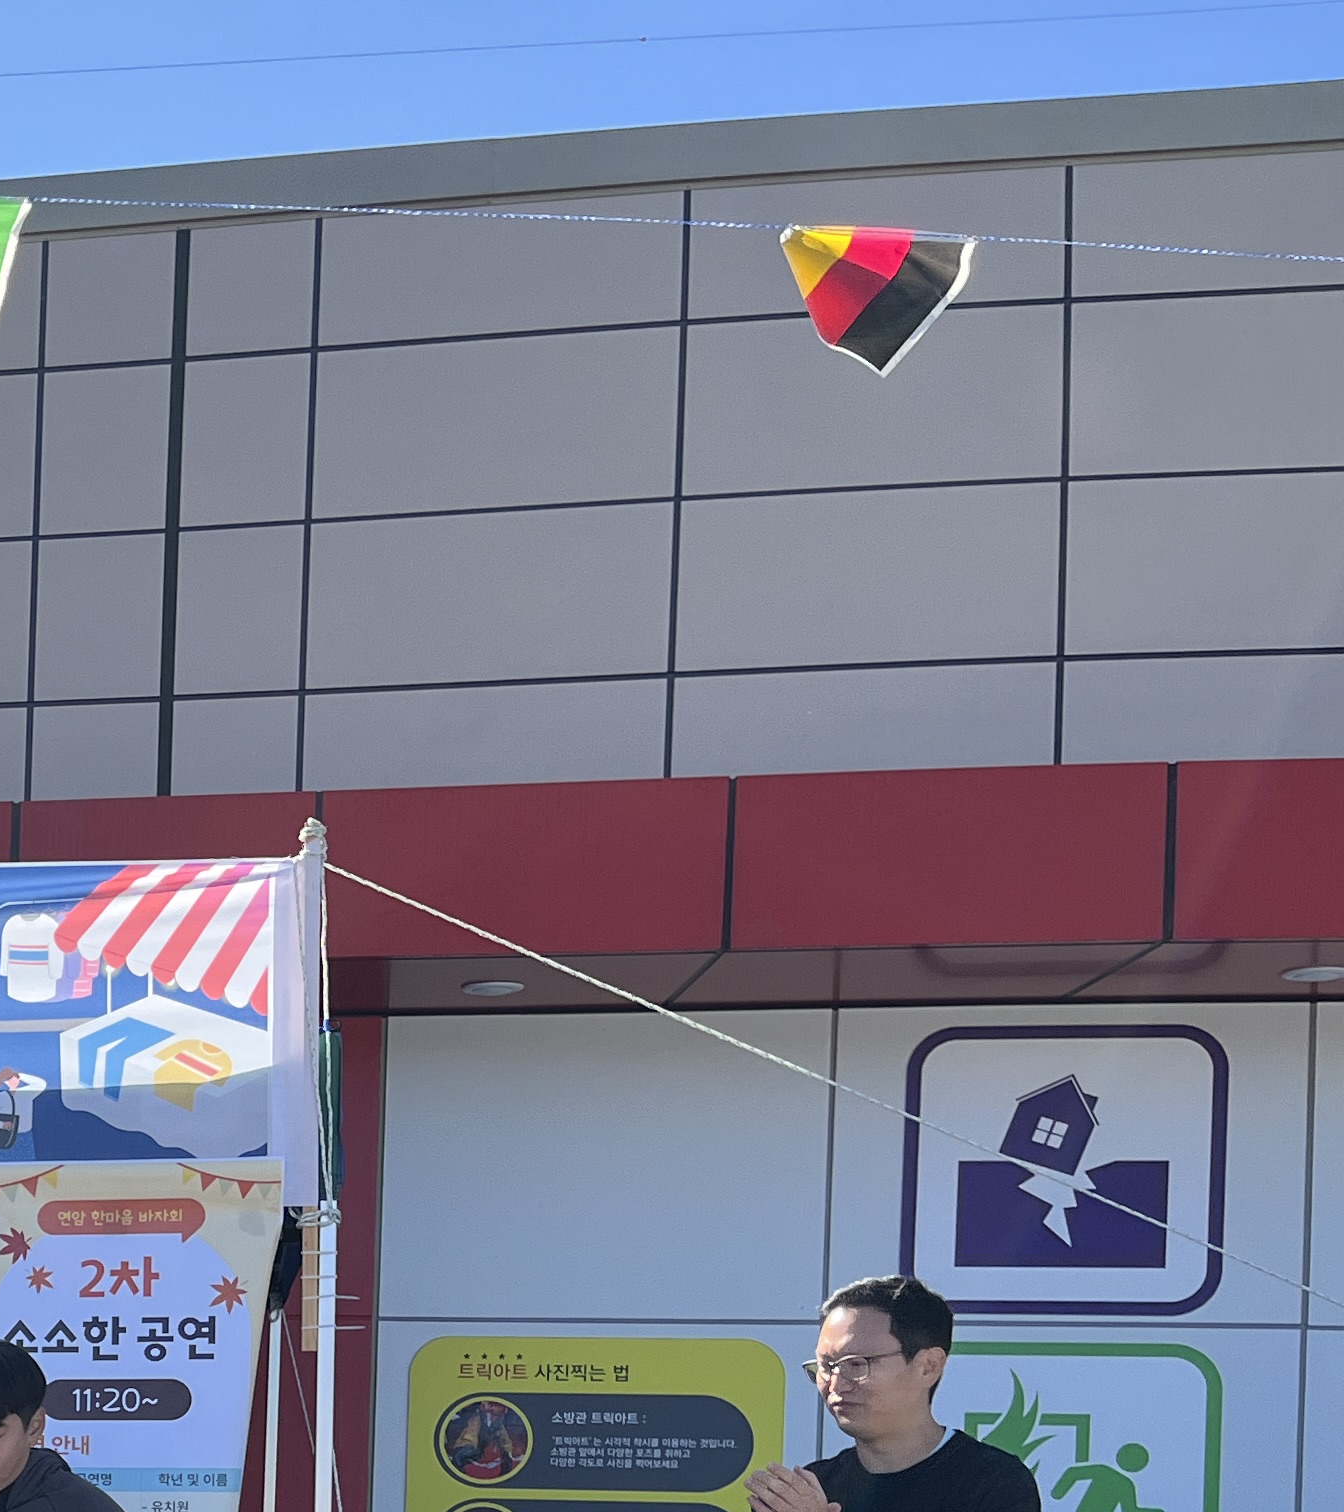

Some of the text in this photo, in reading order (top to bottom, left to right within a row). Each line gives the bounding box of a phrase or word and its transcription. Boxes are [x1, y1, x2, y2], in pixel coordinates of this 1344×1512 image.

[58, 1208, 184, 1227] 연암 한마음 바자회
[78, 1255, 160, 1298] 2차
[4, 1316, 218, 1362] 소소한 공연
[457, 1363, 630, 1383] 트릭아트 사진찍는 법
[72, 1387, 159, 1413] 11:20~
[551, 1412, 587, 1425] 소방관
[591, 1412, 639, 1425] 트릭아트
[52, 1434, 90, 1456] 안내
[158, 1473, 183, 1487] 학년
[187, 1473, 199, 1487] 및
[203, 1473, 228, 1487] 이름
